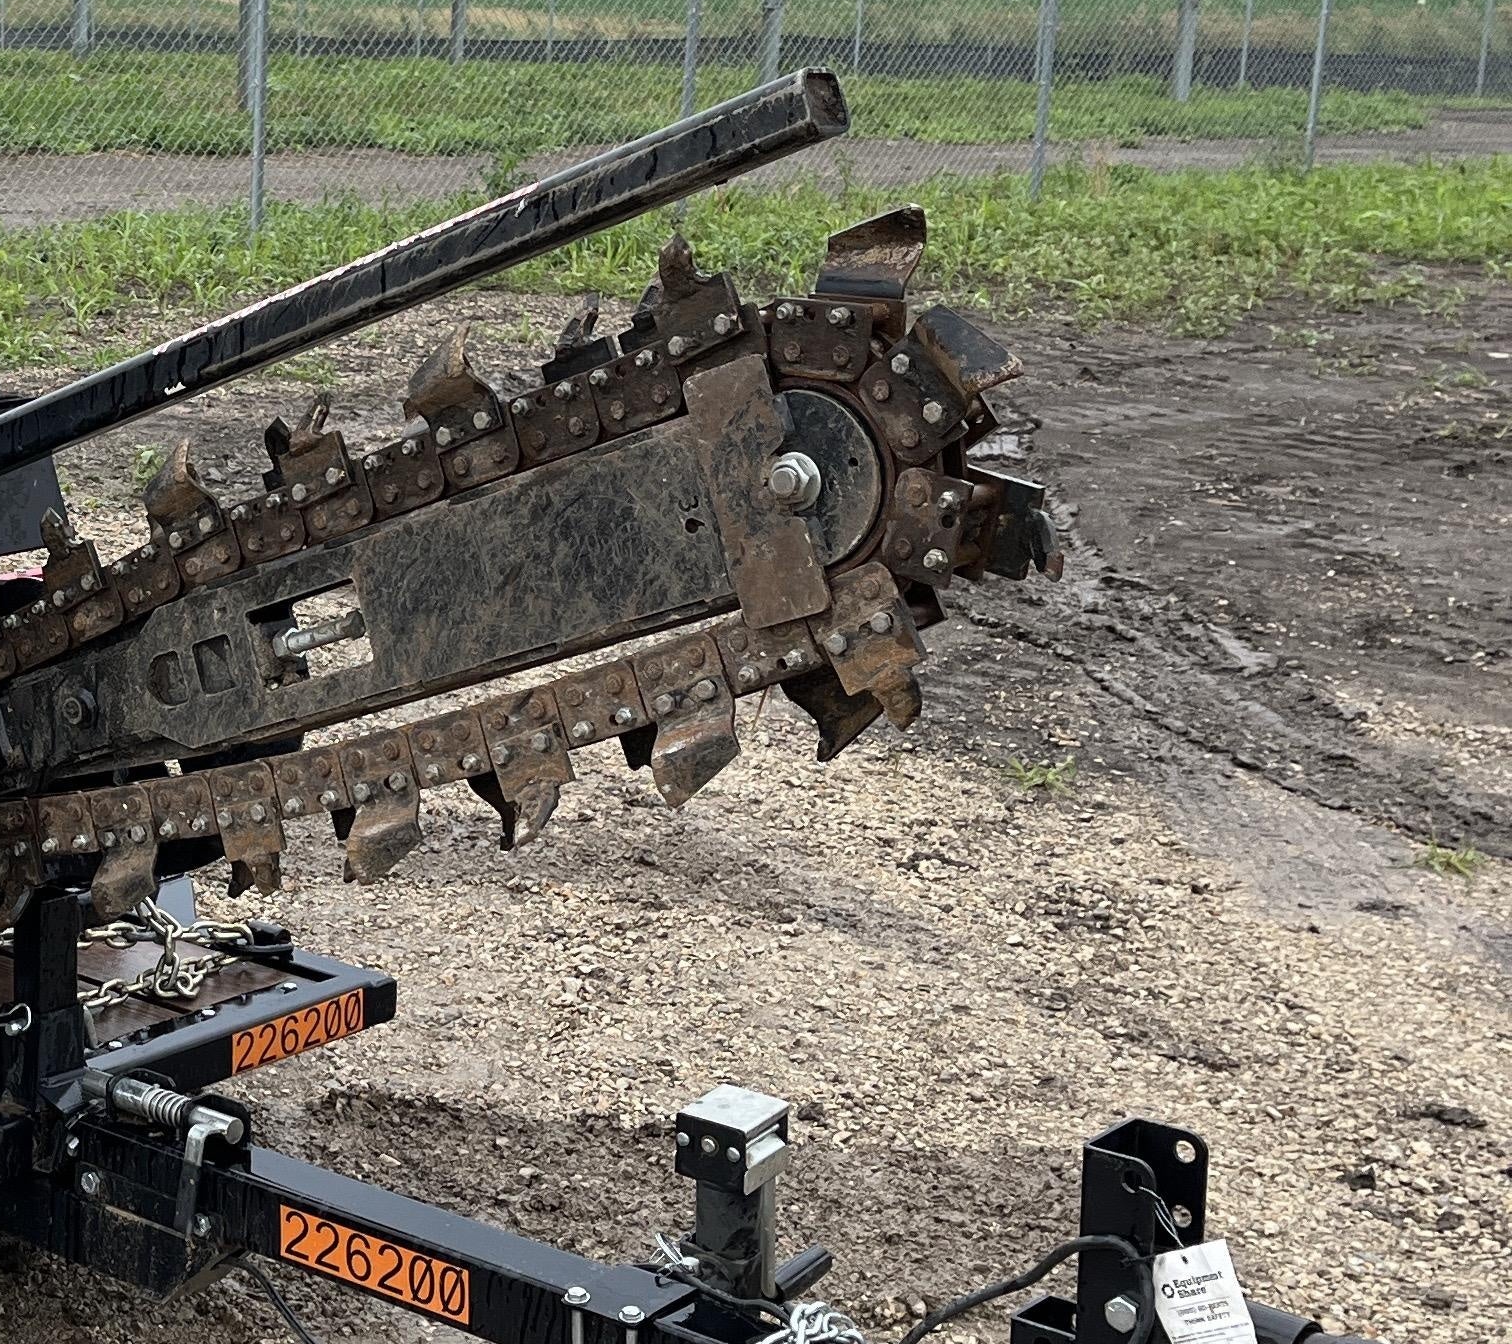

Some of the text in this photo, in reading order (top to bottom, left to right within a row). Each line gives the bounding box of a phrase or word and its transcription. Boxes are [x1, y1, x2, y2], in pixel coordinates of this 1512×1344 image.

[235, 991, 361, 1074] 226200
[285, 1210, 466, 1316] 226200
[1173, 1271, 1223, 1288] Equipment
[1177, 1287, 1206, 1298] Share
